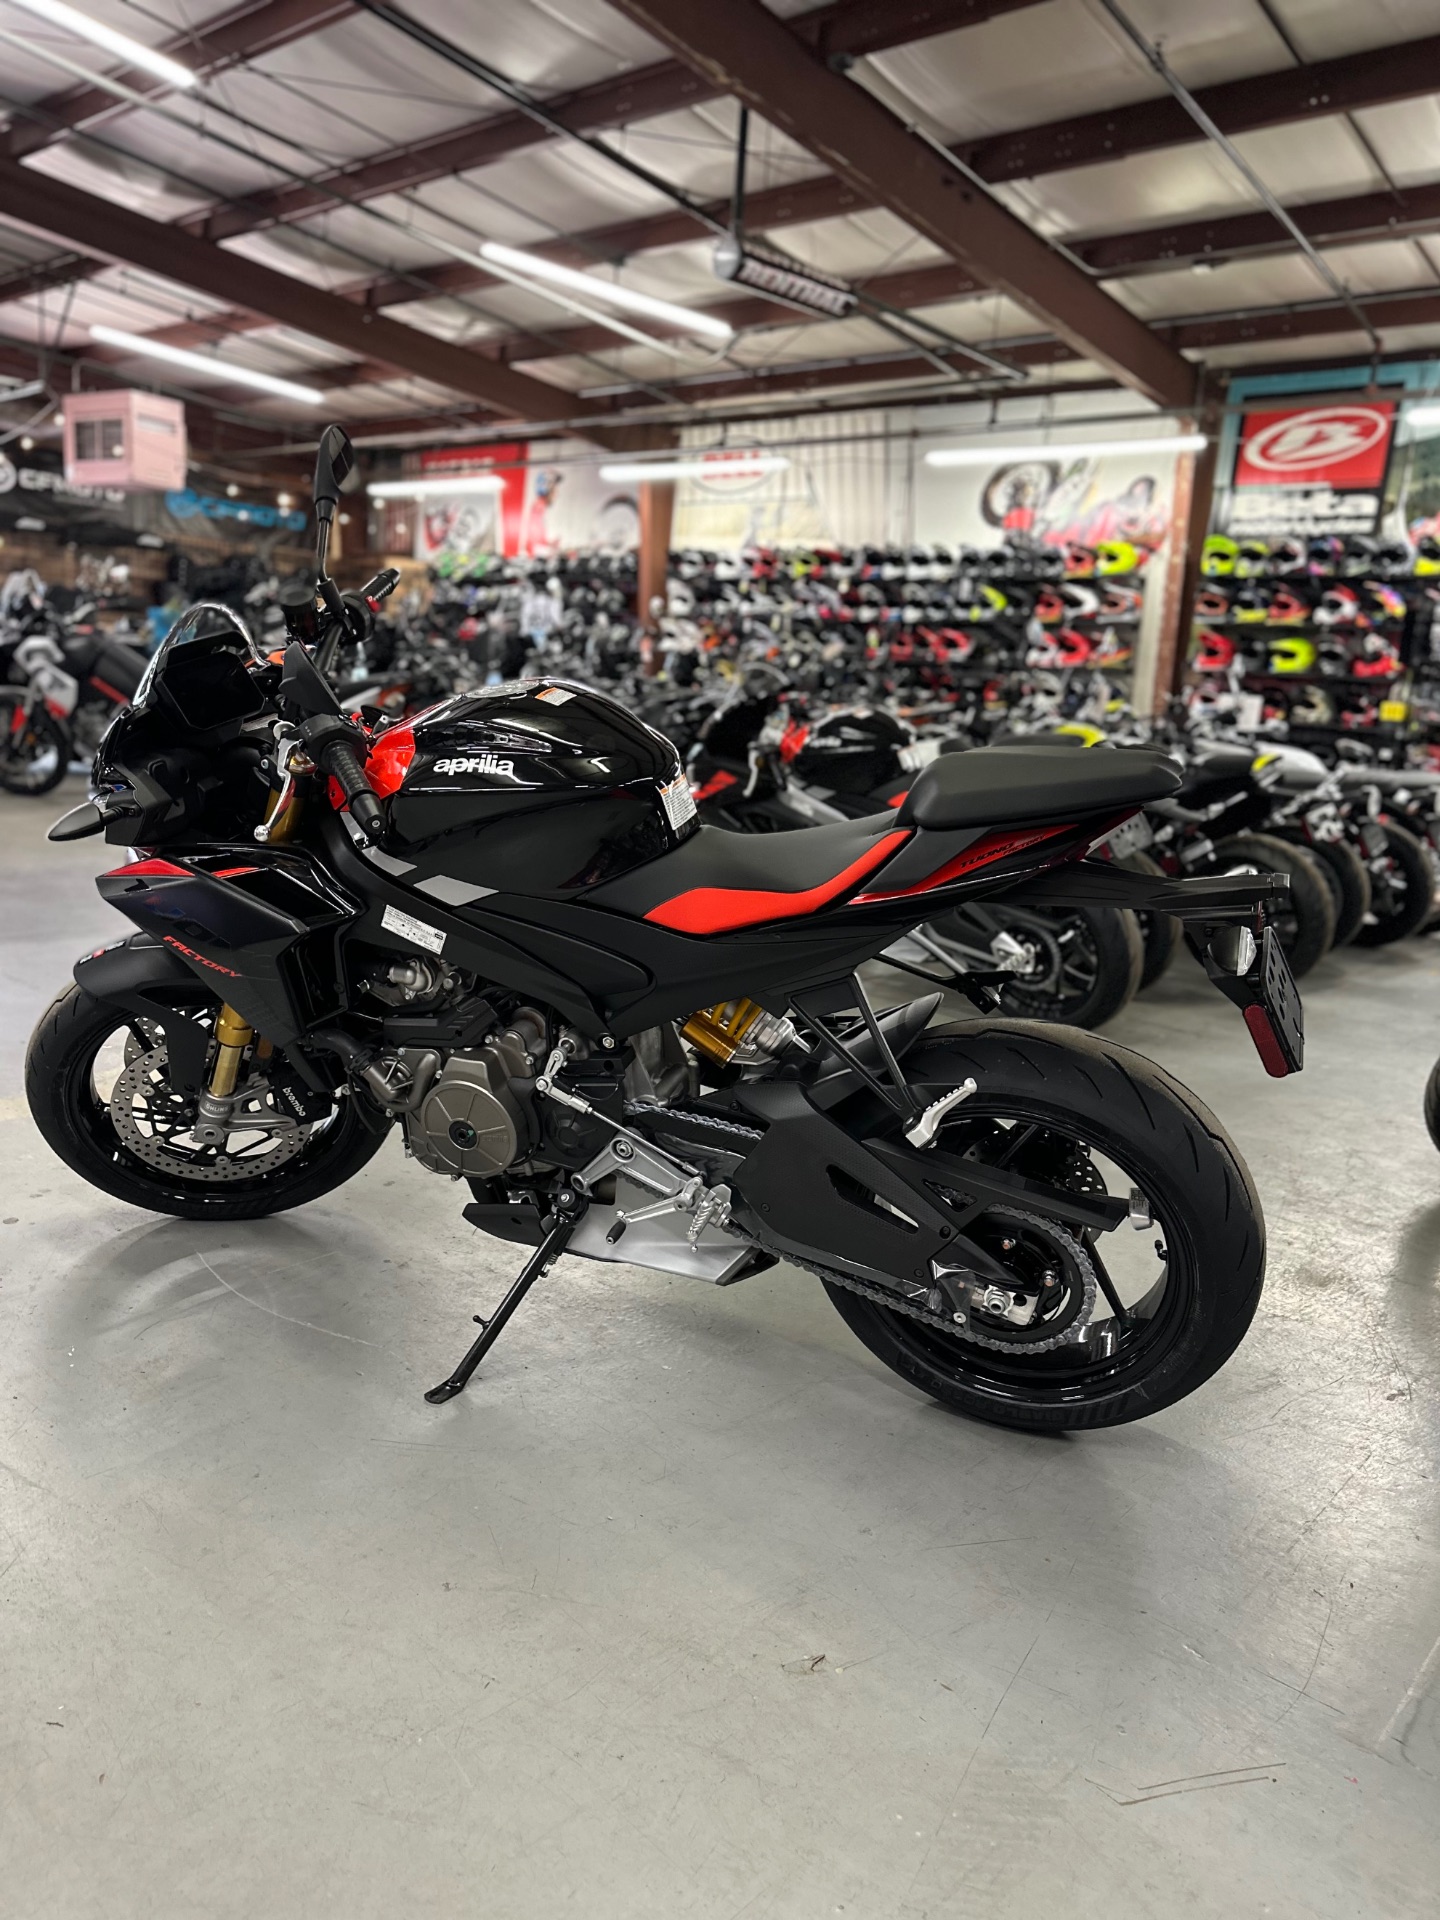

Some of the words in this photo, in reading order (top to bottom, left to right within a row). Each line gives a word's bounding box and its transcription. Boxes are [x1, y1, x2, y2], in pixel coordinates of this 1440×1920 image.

[433, 754, 514, 775] aprilia
[960, 840, 1016, 869] TUONO
[163, 935, 243, 977] FACTORY
[282, 1086, 306, 1117] brembo
